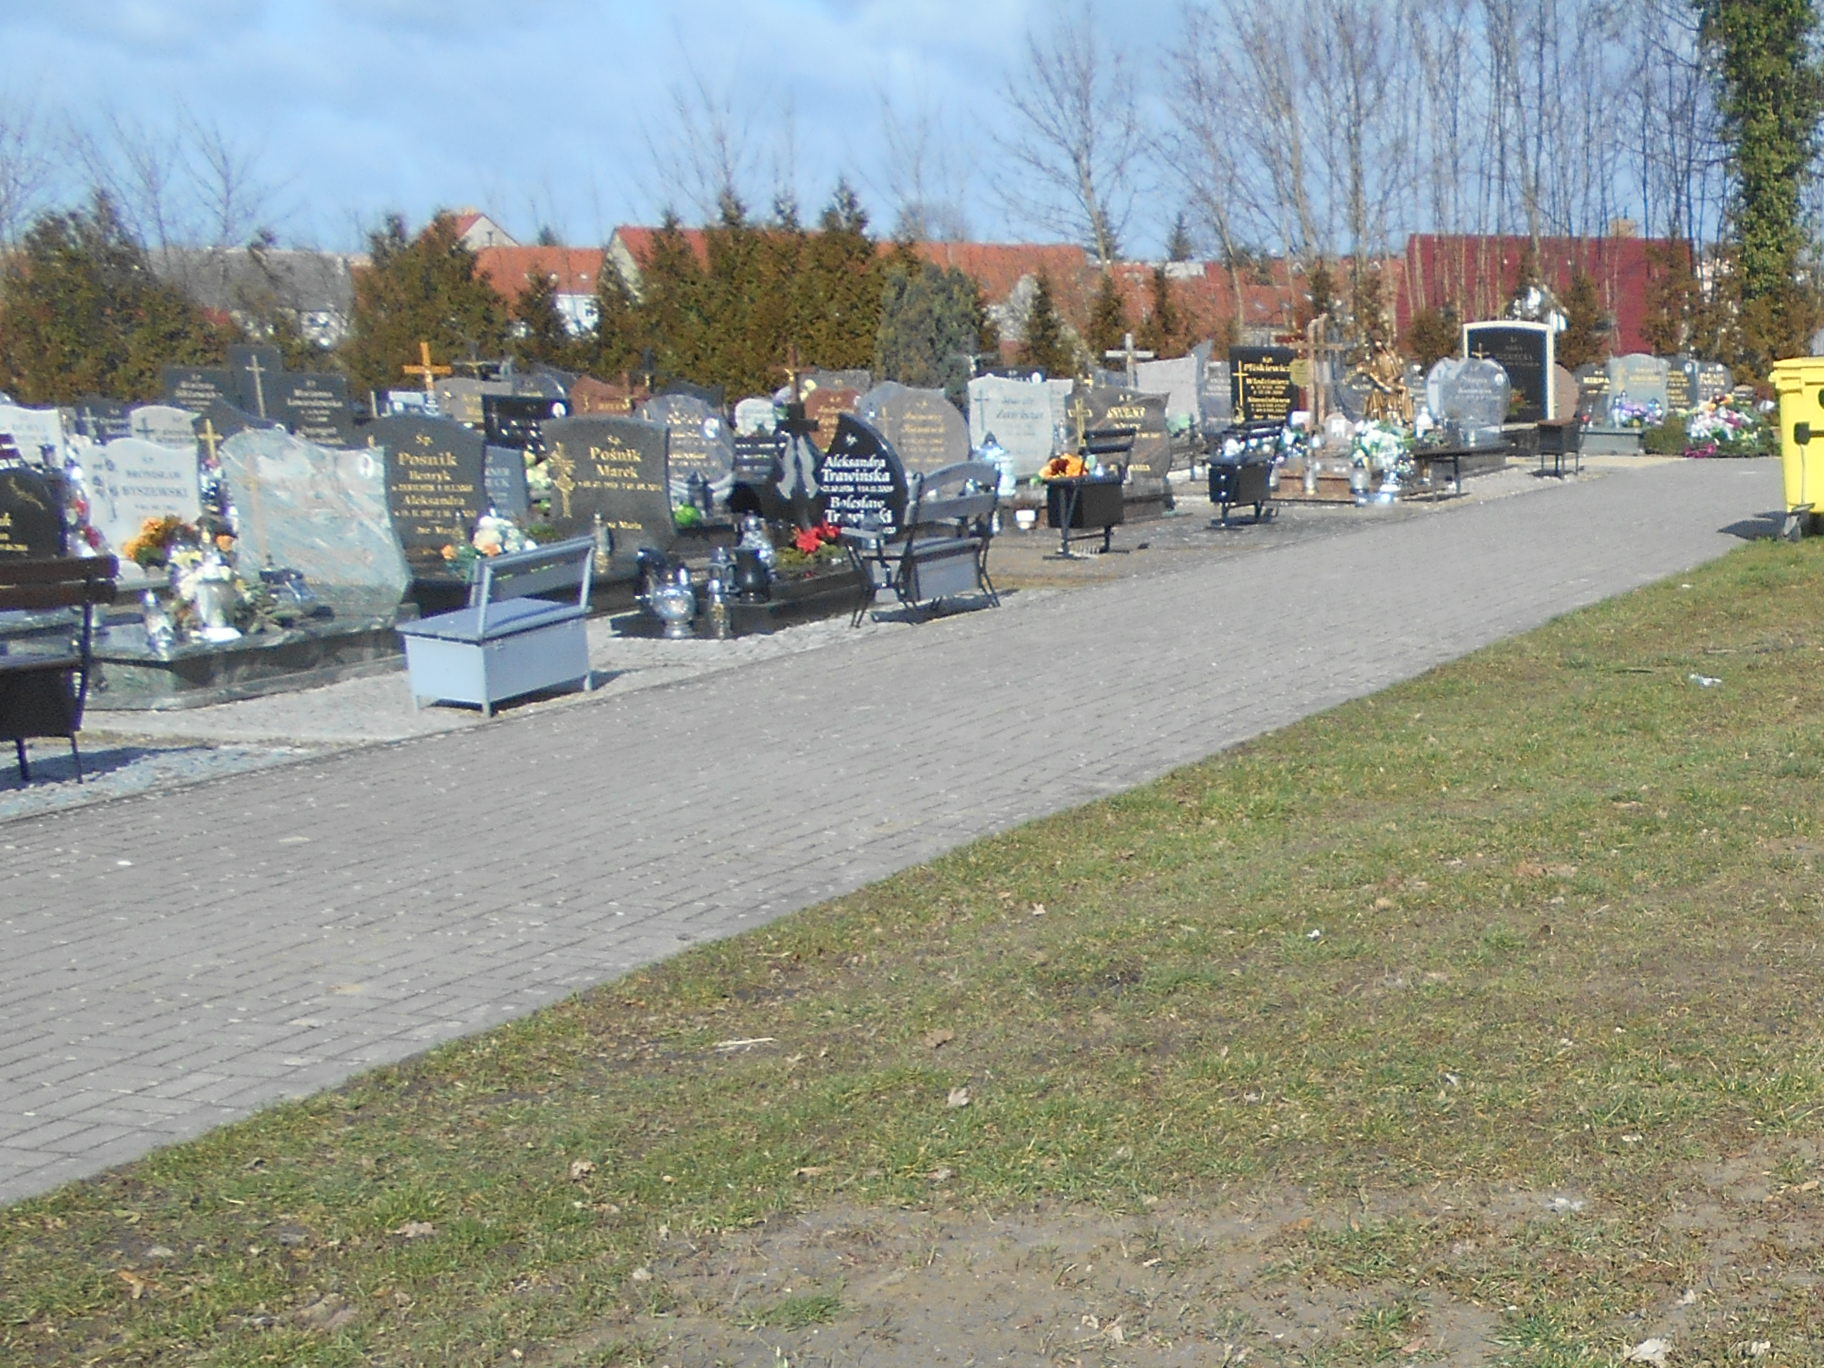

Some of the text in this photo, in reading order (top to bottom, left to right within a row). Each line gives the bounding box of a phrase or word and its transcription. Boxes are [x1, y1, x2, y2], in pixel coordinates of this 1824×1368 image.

[589, 446, 642, 462] Pośnik
[823, 453, 886, 468] Aleksandra
[596, 463, 639, 478] Marek
[821, 466, 891, 482] Trawińska
[404, 494, 466, 506] Aleksandra
